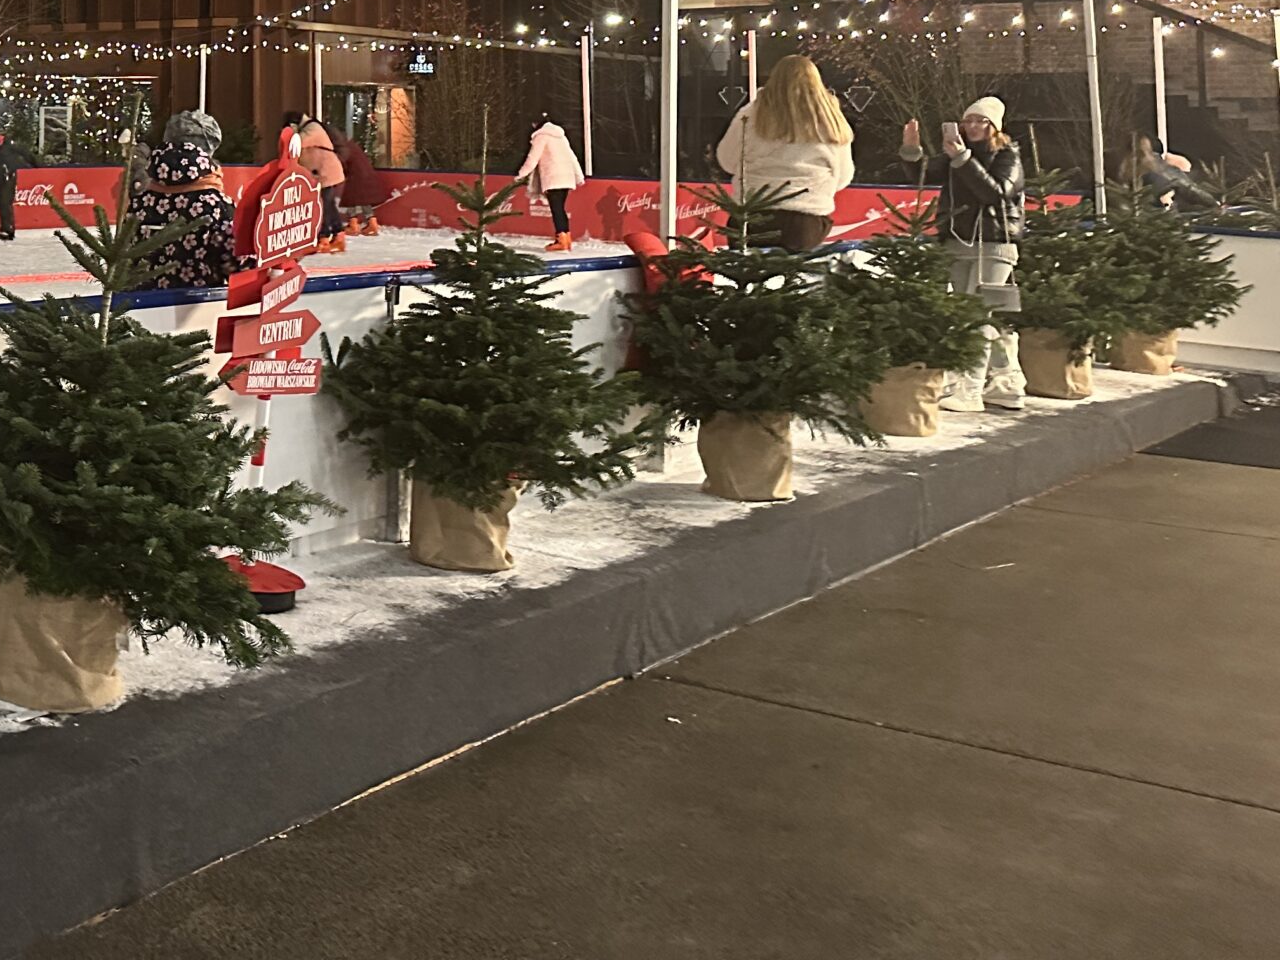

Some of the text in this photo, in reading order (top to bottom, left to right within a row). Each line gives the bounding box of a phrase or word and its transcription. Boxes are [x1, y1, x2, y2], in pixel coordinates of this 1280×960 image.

[283, 185, 301, 206] WITAJ
[268, 201, 313, 232] W BROWARACH
[267, 222, 312, 253] WARSZAWSKICH
[259, 317, 303, 345] CENTRUM
[249, 360, 287, 374] LODOWISKO
[247, 375, 317, 388] BROWARY WARSZAWSKIE
